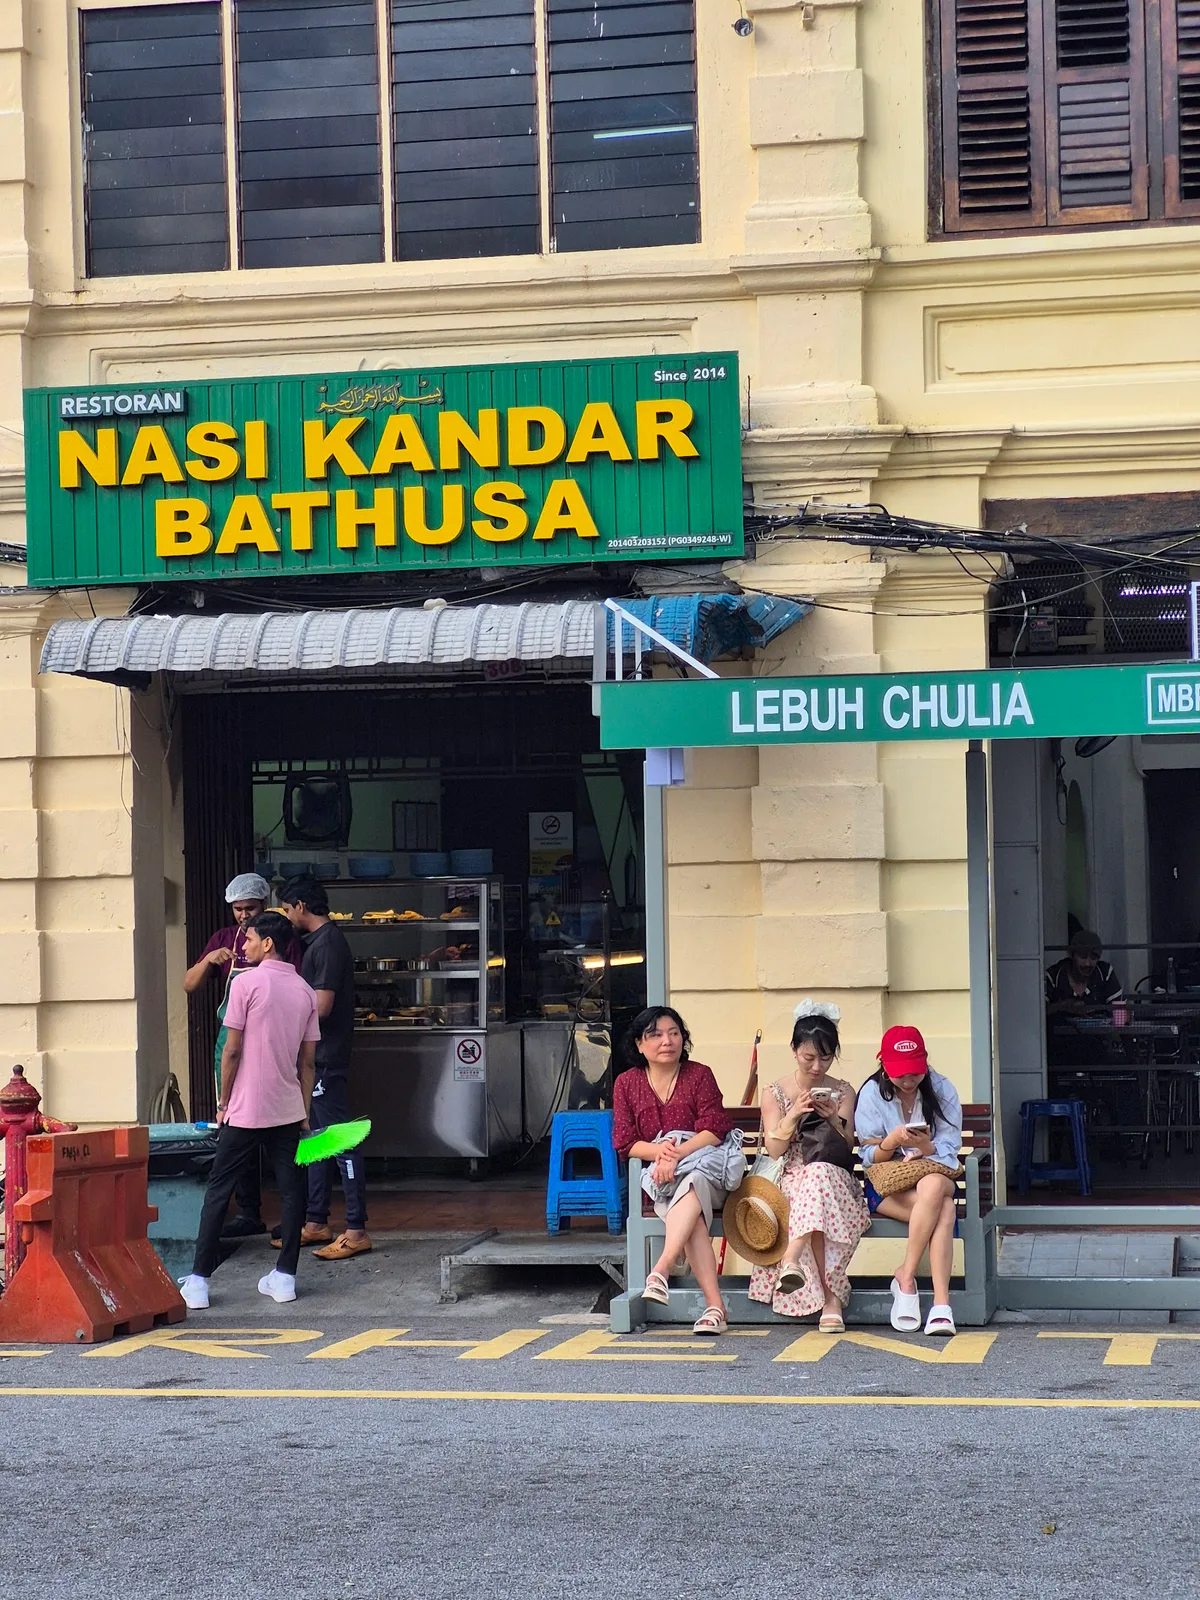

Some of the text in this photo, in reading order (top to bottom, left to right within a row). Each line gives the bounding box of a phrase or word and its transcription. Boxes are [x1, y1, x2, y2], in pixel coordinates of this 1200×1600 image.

[653, 366, 726, 382] Since 2014
[61, 391, 182, 416] RESTORAN
[58, 398, 701, 489] NASI KANDAR
[155, 478, 601, 557] BATHUSA
[608, 534, 732, 548] 201403203152 (PG0349248-W)
[731, 682, 1035, 733] LEBUH CHULIA
